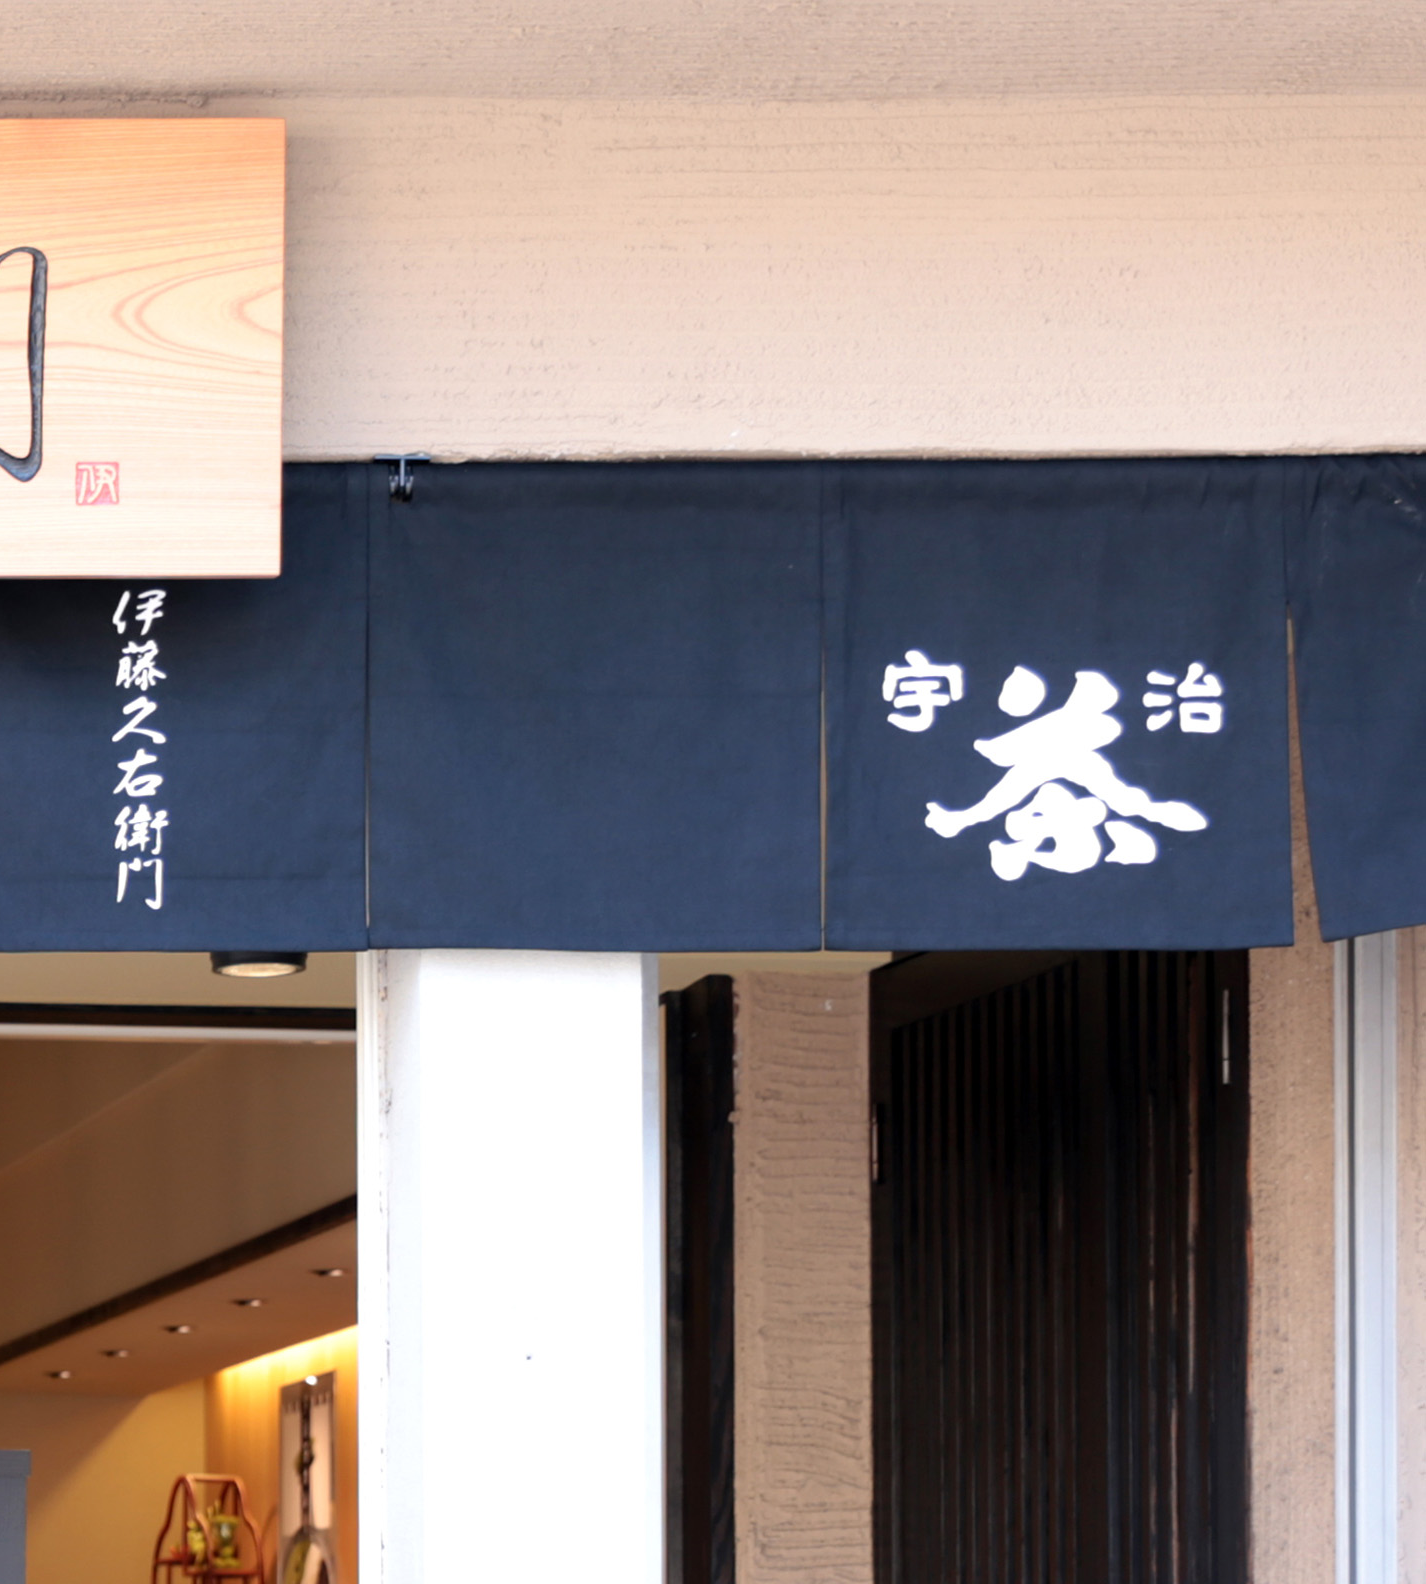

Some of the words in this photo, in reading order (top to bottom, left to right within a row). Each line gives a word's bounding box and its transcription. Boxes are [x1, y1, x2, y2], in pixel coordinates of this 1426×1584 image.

[112, 590, 168, 909] 伊藤久右衛門
